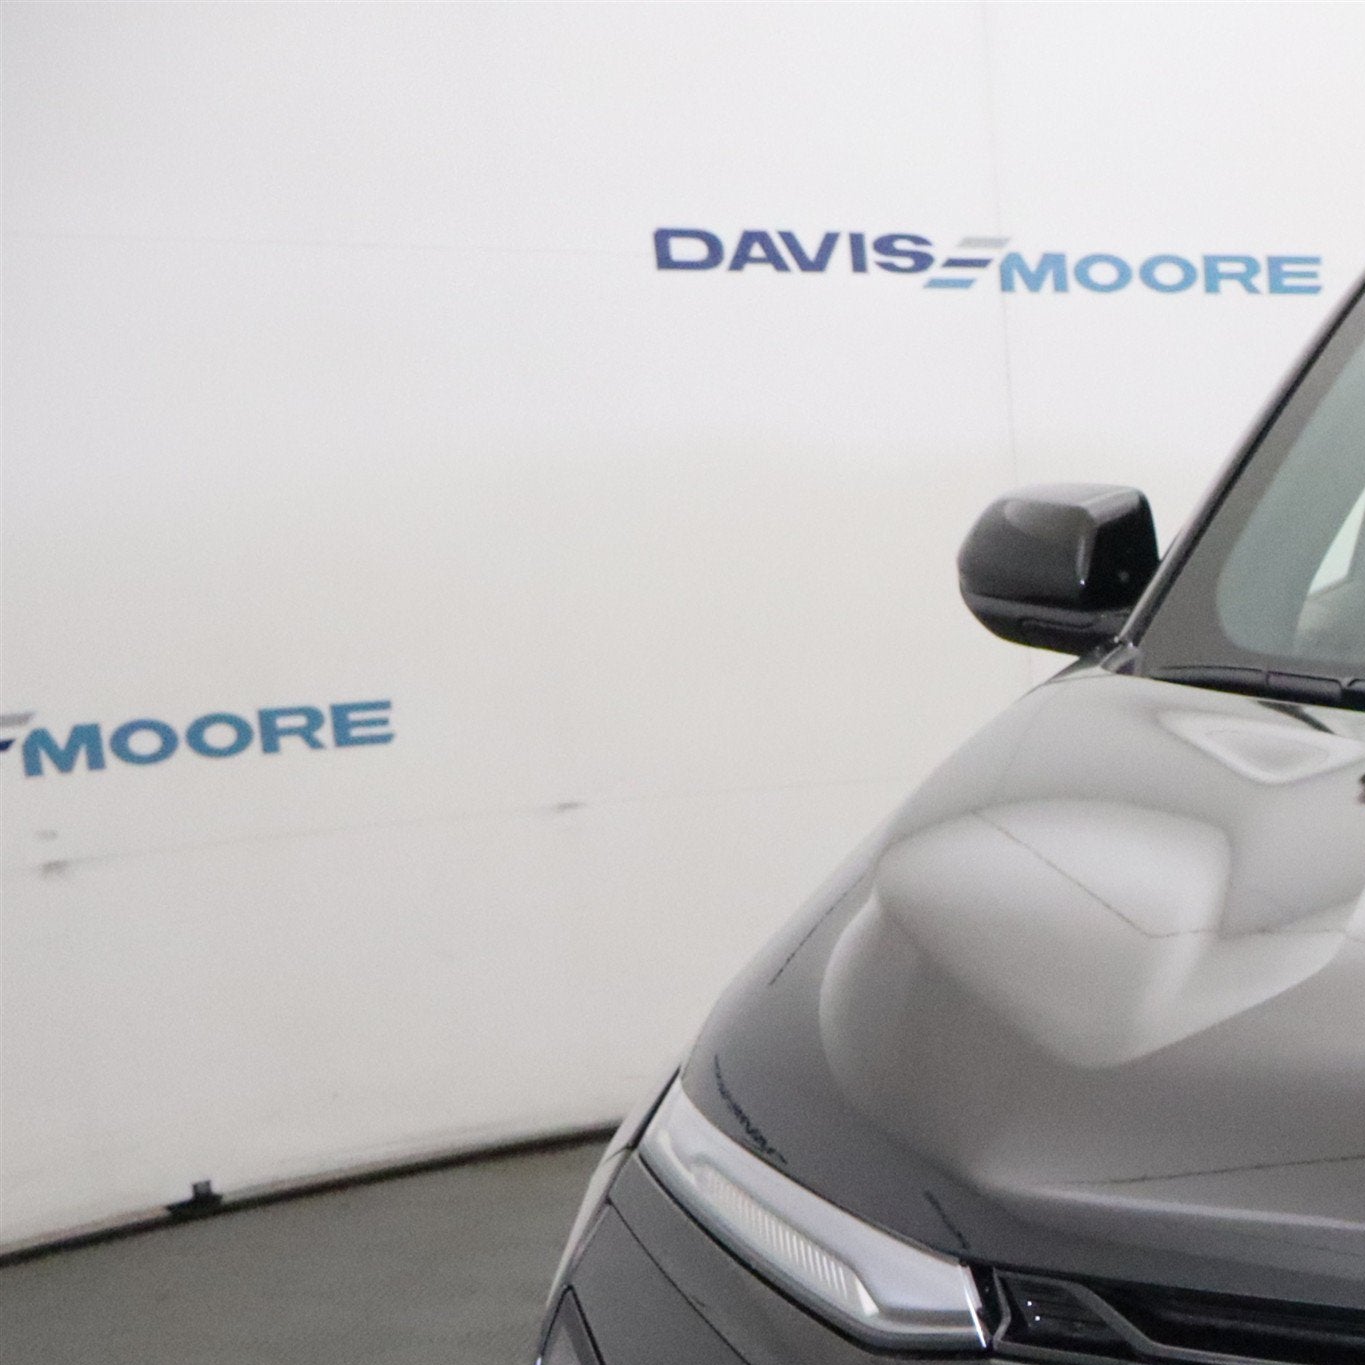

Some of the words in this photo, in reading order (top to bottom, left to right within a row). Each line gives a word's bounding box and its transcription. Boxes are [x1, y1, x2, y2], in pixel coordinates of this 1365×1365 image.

[653, 227, 936, 273] DAVIS
[999, 251, 1323, 296] MOORE
[21, 699, 395, 777] MOORE
